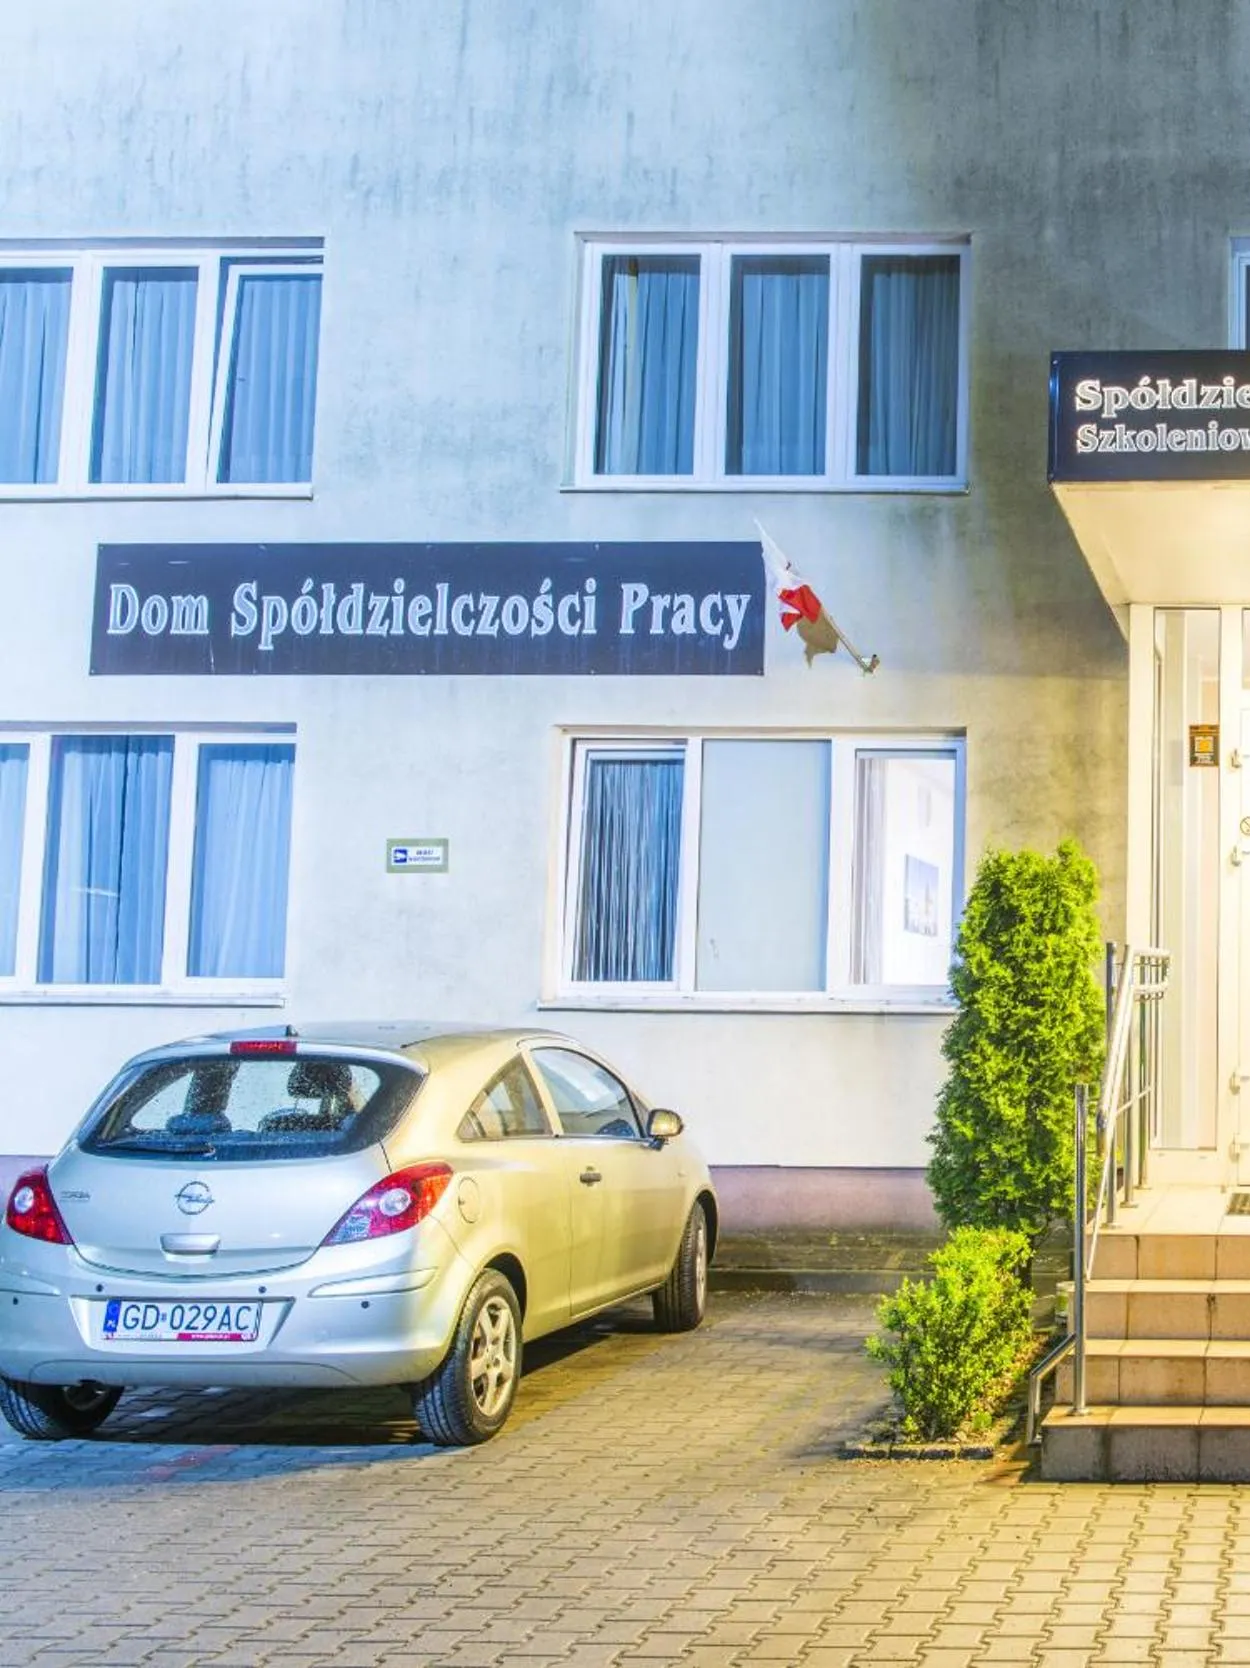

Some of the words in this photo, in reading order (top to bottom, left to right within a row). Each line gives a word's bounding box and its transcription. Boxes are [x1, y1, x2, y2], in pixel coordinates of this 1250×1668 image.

[107, 582, 210, 635] Dom
[231, 577, 598, 650] Spółdzielczości
[618, 582, 752, 650] Pracy
[123, 1304, 160, 1330] GD
[170, 1304, 251, 1331] 029AC
